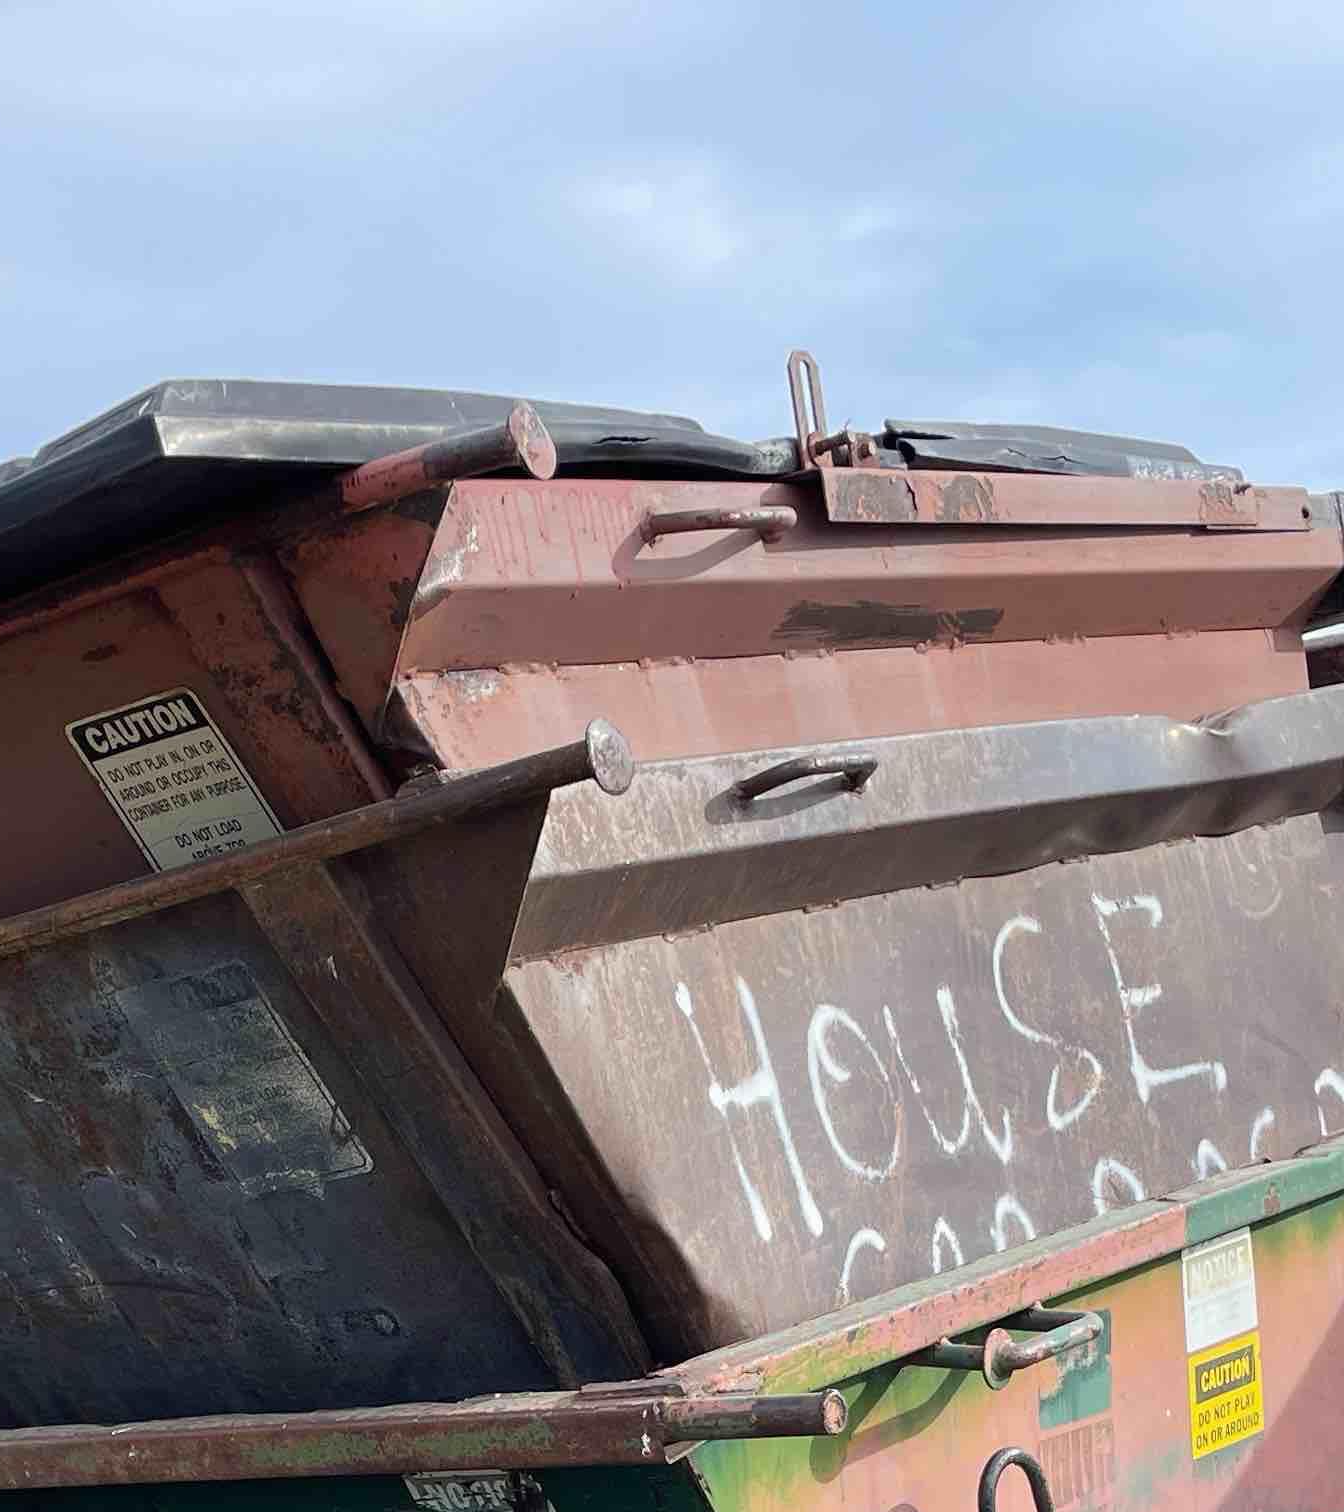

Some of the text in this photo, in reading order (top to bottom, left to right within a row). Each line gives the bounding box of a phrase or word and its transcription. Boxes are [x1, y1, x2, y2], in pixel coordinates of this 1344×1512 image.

[84, 699, 197, 753] CAUTION
[107, 768, 125, 783] DO
[123, 761, 145, 777] NOT
[144, 754, 169, 770] PLAY
[183, 744, 201, 759] ON
[199, 739, 217, 754] OR
[119, 757, 232, 801] AROUND OR OCCUPY THIS
[127, 776, 247, 822] CONTAINER FOR ANY PURPOSE
[175, 819, 243, 848] DO NOT LOAD
[675, 892, 1227, 1242] HOUSE
[1200, 1354, 1250, 1392] CAUTION
[1196, 1411, 1260, 1450] ON OR AROUND
[1198, 1391, 1256, 1427] DO NOT PLAY
